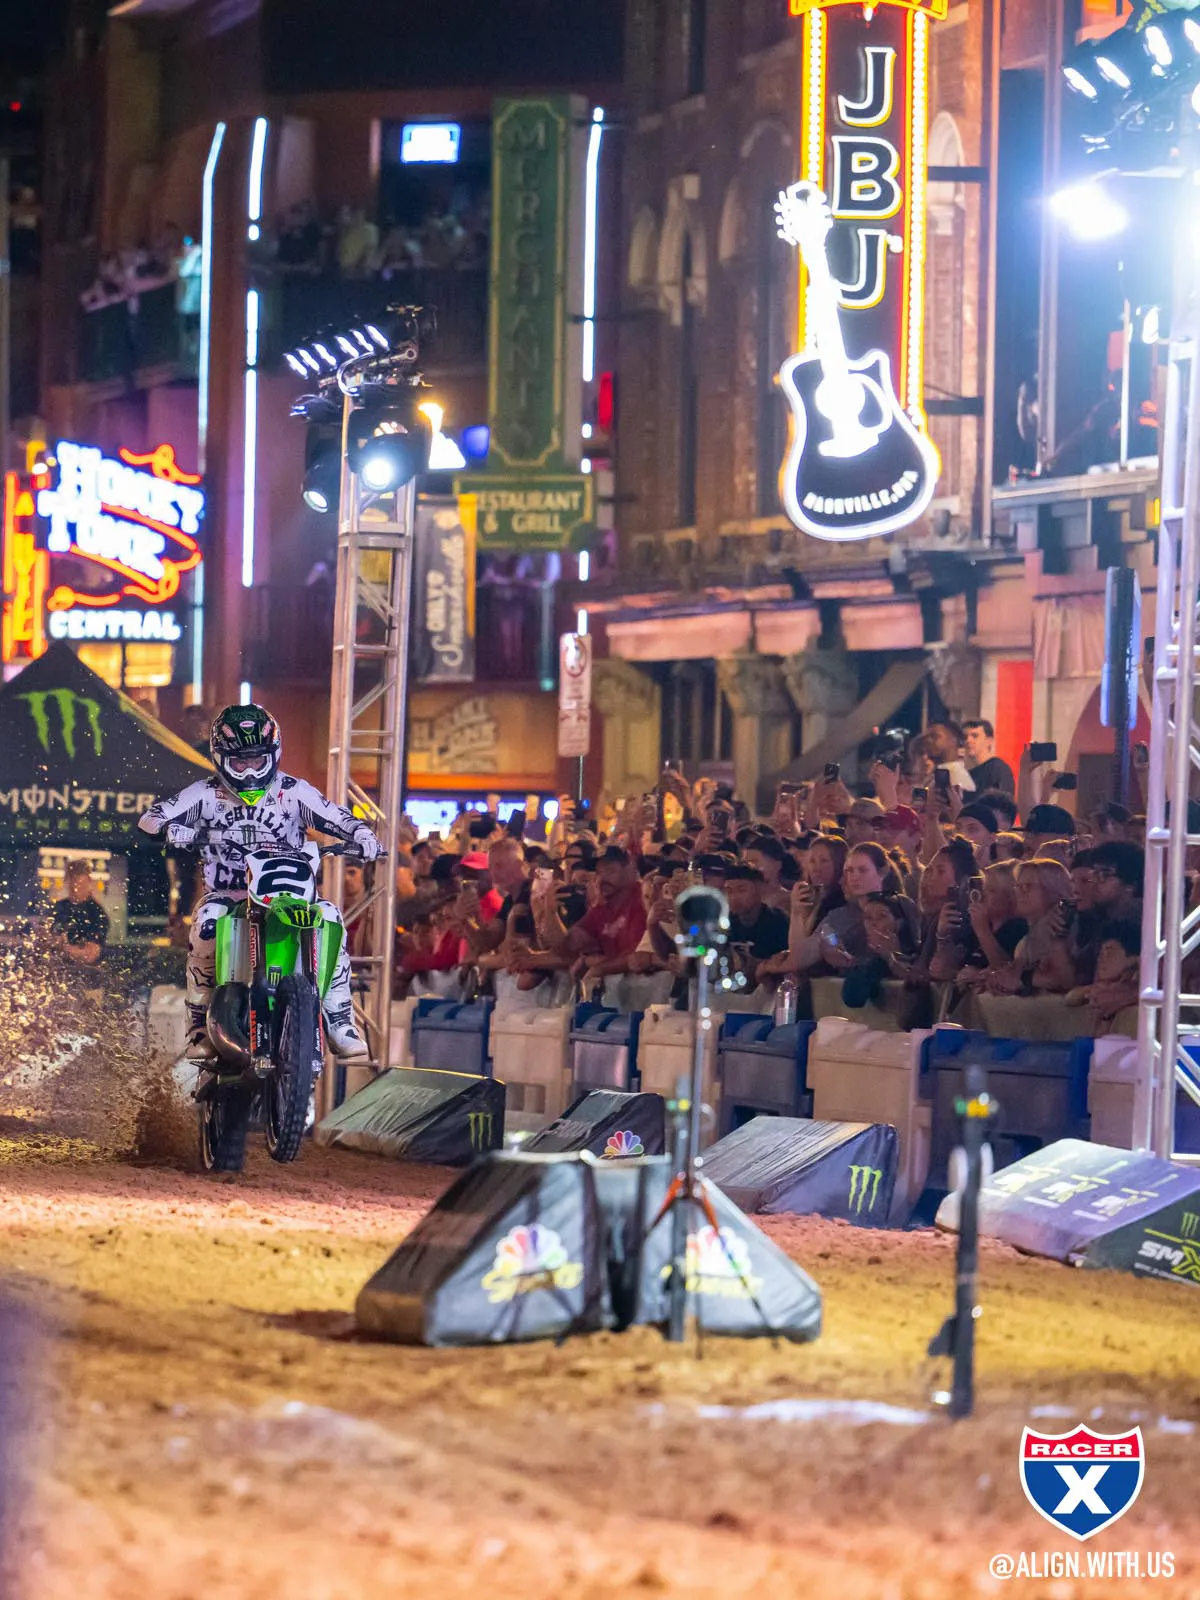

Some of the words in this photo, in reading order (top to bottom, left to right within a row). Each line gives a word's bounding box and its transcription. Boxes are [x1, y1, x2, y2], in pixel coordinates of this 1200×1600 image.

[56, 440, 204, 534] HONKY
[37, 489, 166, 580] TONK
[512, 512, 563, 533] GRILL
[50, 609, 181, 641] CENTRAL
[256, 858, 313, 896] 2
